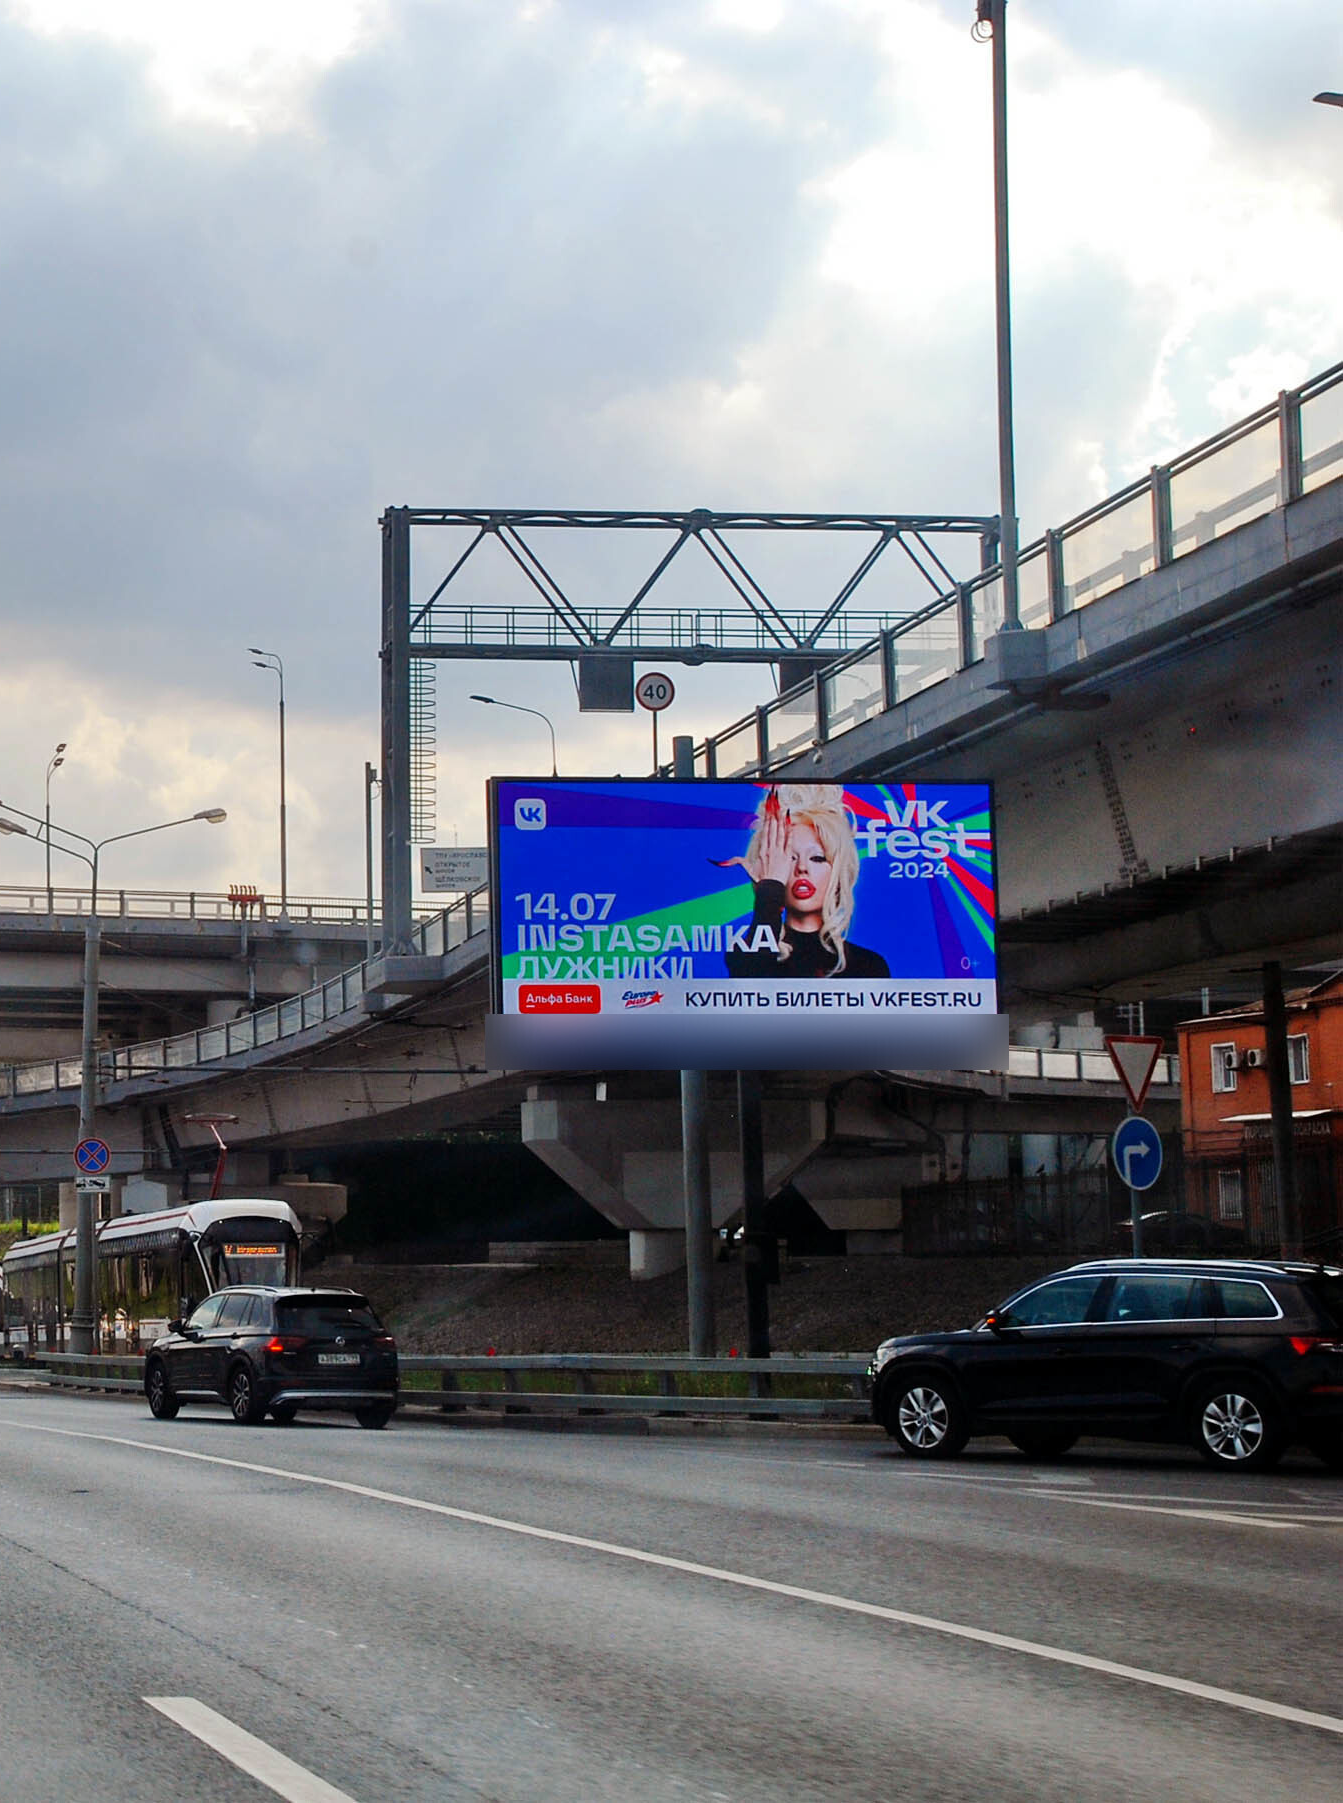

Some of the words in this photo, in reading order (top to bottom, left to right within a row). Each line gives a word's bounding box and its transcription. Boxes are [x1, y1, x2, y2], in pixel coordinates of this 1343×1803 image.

[643, 684, 667, 700] 40
[884, 800, 950, 828] VK
[856, 819, 990, 859] fest
[889, 862, 950, 878] 2024
[515, 893, 616, 921] 14.07
[518, 925, 779, 953] INSTASAMKA
[517, 956, 693, 979] ЛУЖНИКИ
[526, 993, 563, 1007] Альфа
[565, 993, 594, 1004] Банк
[685, 992, 770, 1007] КУПИТЬ
[776, 992, 864, 1007] БИЛЕТЫ
[870, 992, 982, 1007] VKFEST.RU
